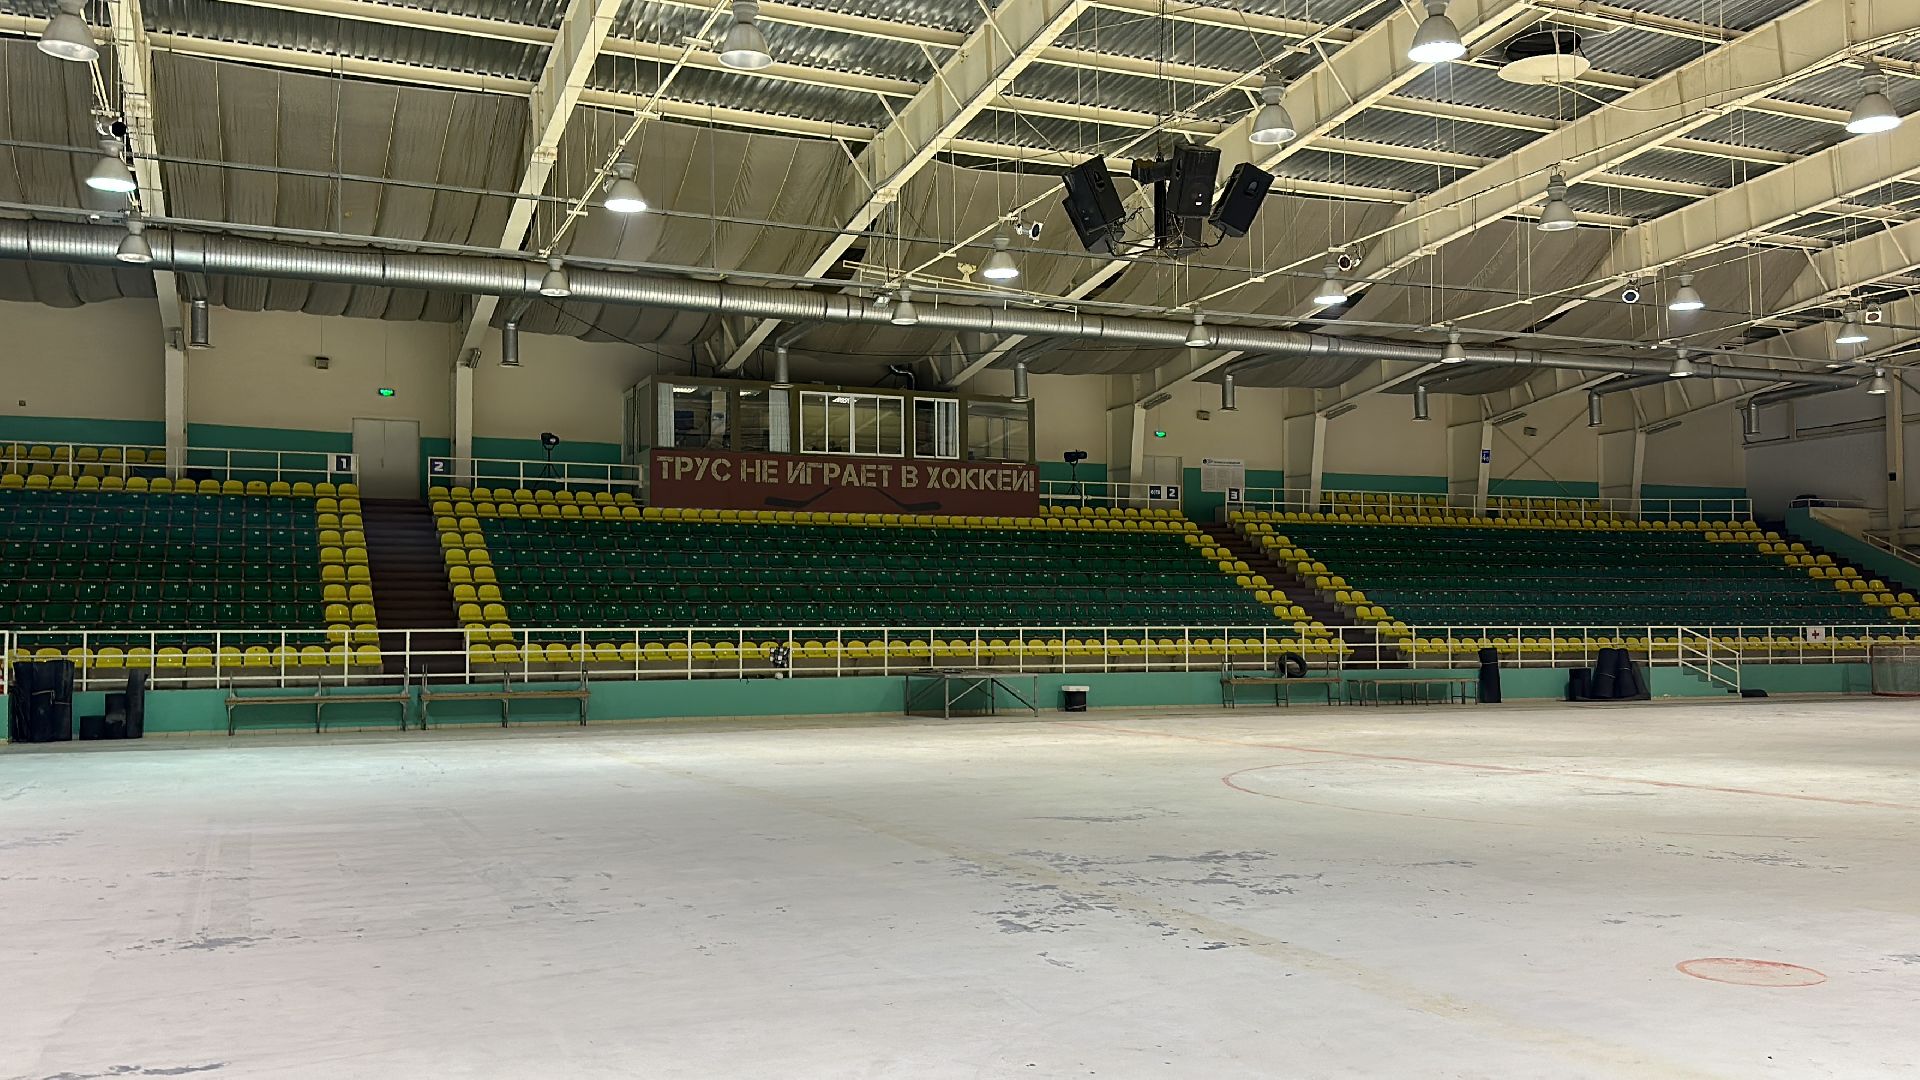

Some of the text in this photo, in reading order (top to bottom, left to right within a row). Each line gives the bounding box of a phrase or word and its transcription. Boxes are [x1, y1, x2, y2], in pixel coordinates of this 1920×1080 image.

[340, 457, 347, 469] 1
[434, 461, 444, 472] 2
[657, 455, 1035, 492] ТРУС НЕ ИГРАЕТ В ХОККЕЙ!
[1169, 488, 1176, 497] 2
[1230, 491, 1238, 500] 3
